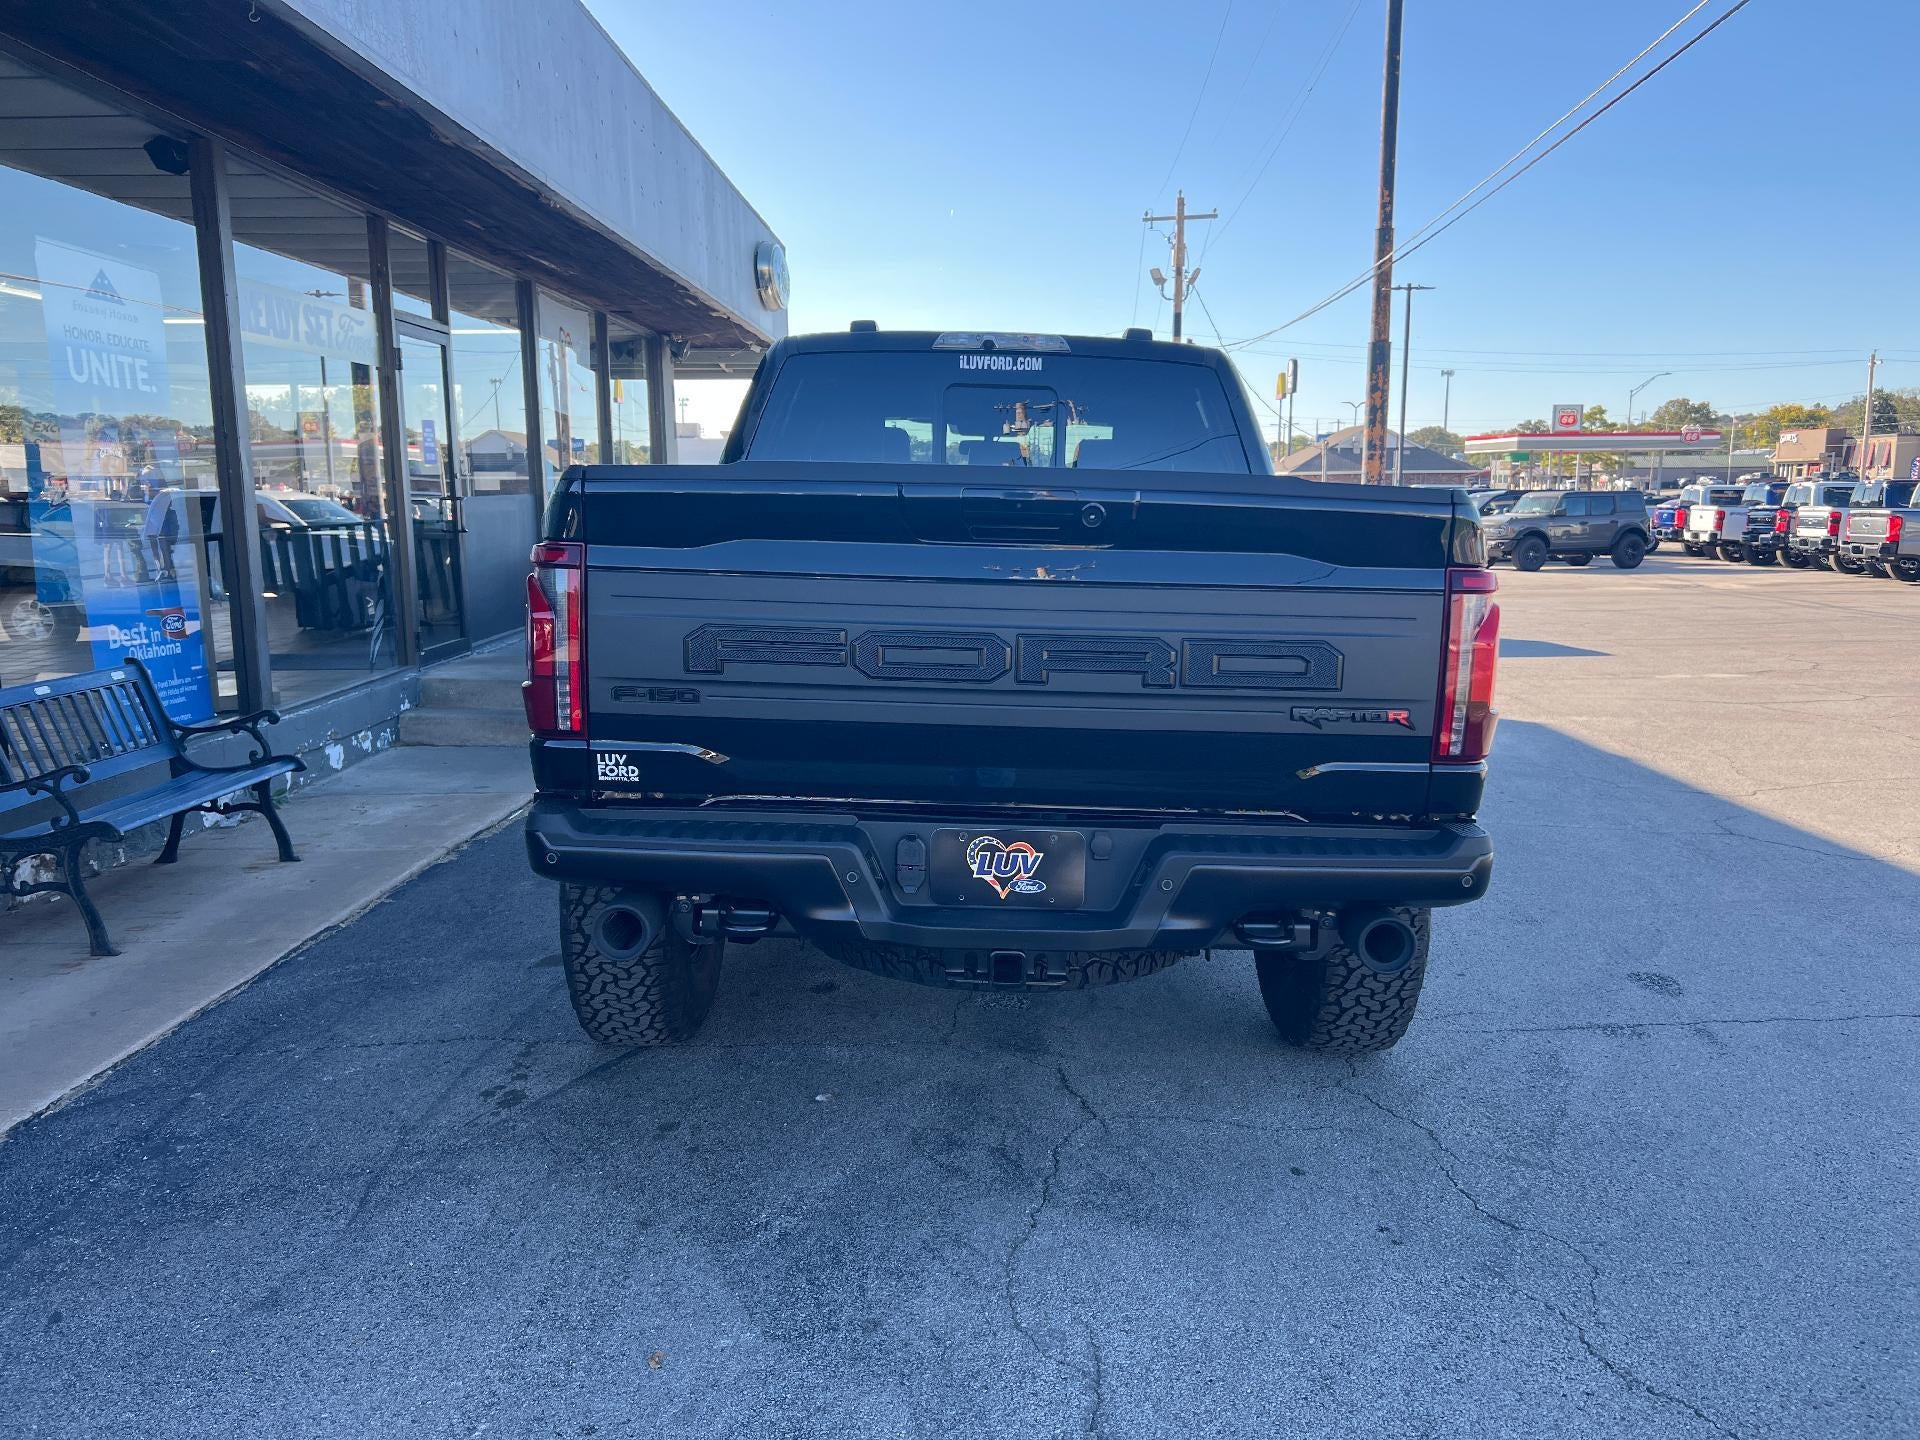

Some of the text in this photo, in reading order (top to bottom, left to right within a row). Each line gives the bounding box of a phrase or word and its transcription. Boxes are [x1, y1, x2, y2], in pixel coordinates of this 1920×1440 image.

[63, 324, 104, 345] HONOR.
[66, 346, 157, 392] UNITE.
[960, 355, 1043, 371] iLUVFORD.COM
[108, 622, 161, 650] Best in
[128, 642, 182, 660] Oklahoma
[683, 623, 1345, 692] FORD
[611, 686, 701, 705] F-150
[1290, 706, 1416, 731] RAPTOR
[596, 753, 627, 766] LUV
[597, 765, 639, 777] FORD
[973, 852, 1044, 877] LUV
[1012, 880, 1041, 892] Ford
